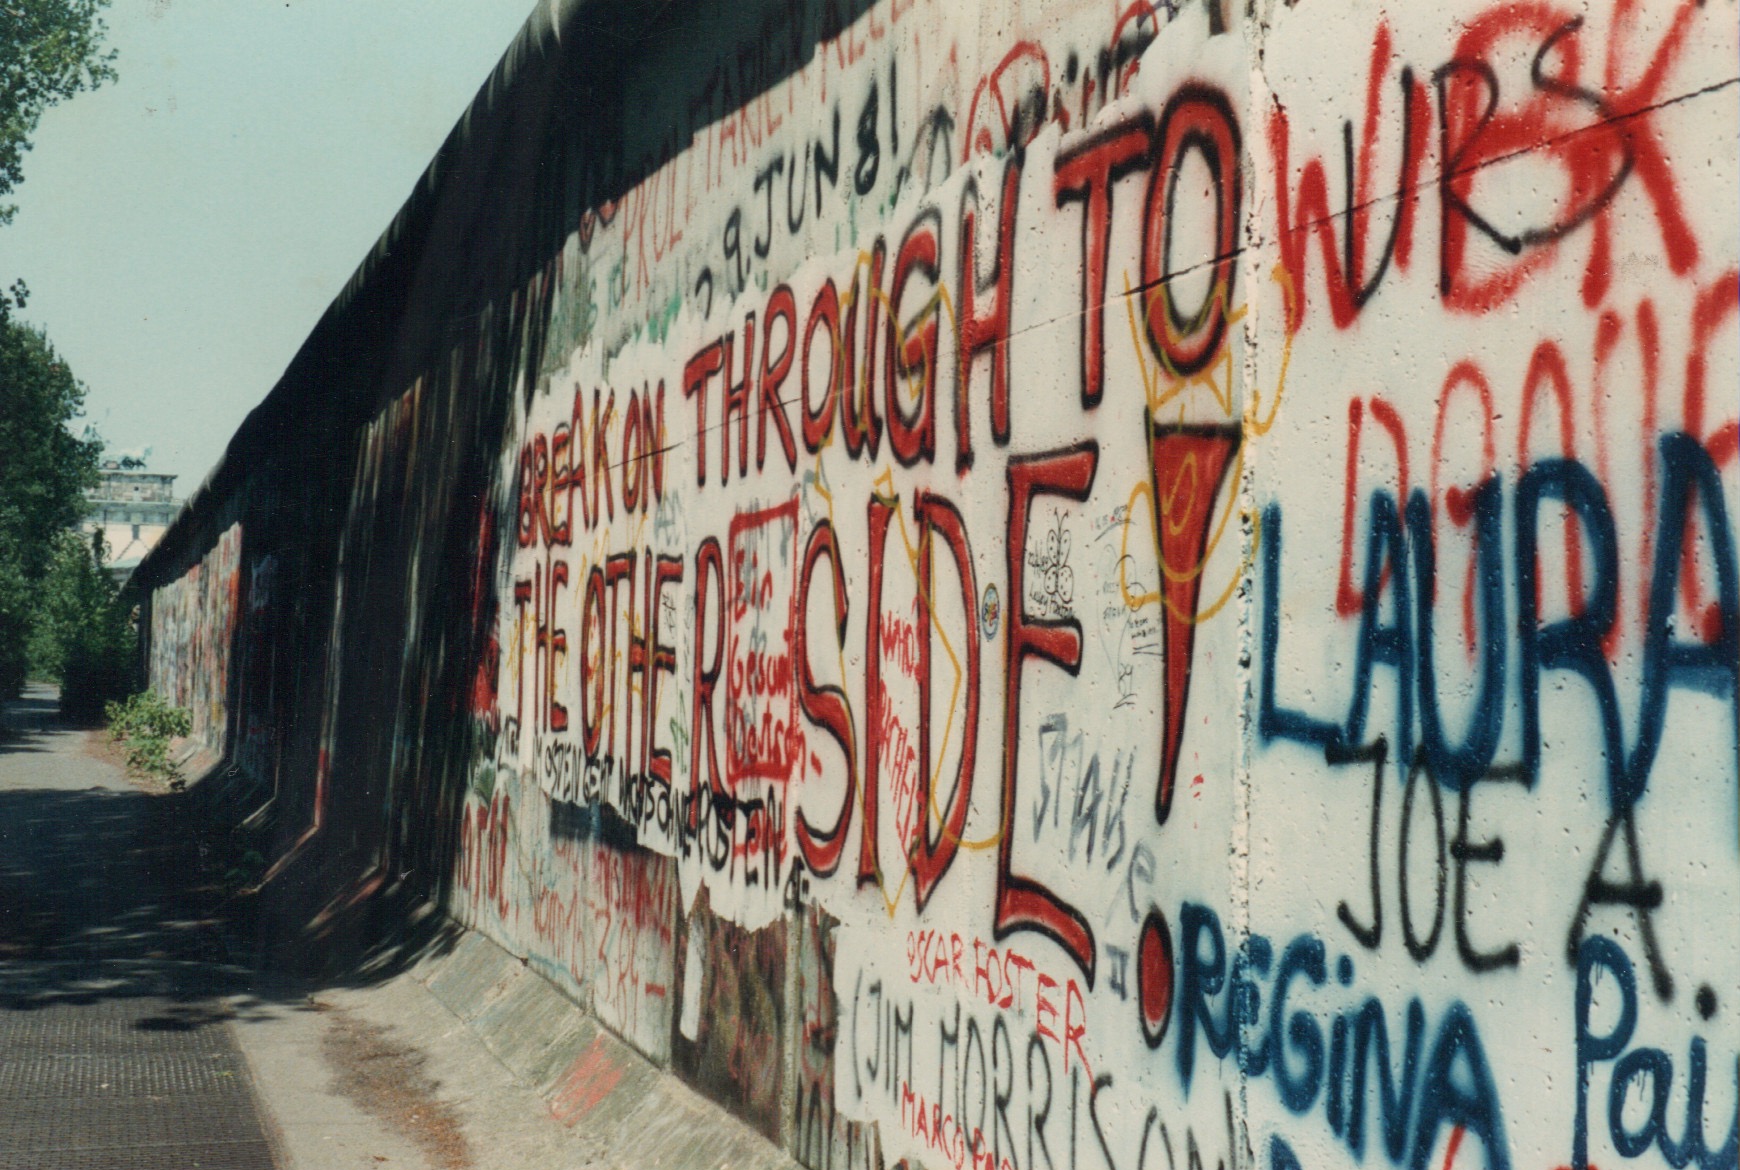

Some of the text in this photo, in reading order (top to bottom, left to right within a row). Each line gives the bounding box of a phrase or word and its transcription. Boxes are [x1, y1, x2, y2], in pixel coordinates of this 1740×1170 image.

[519, 379, 613, 549] BREAK
[622, 378, 665, 516] ON
[683, 148, 1025, 488] THROUGH
[1053, 76, 1243, 412] TO
[514, 556, 569, 742] THE
[580, 535, 733, 832] OTHER
[1255, 425, 1740, 815] LAURA
[907, 928, 966, 990] OSCAR
[1324, 735, 1521, 972] JOE
